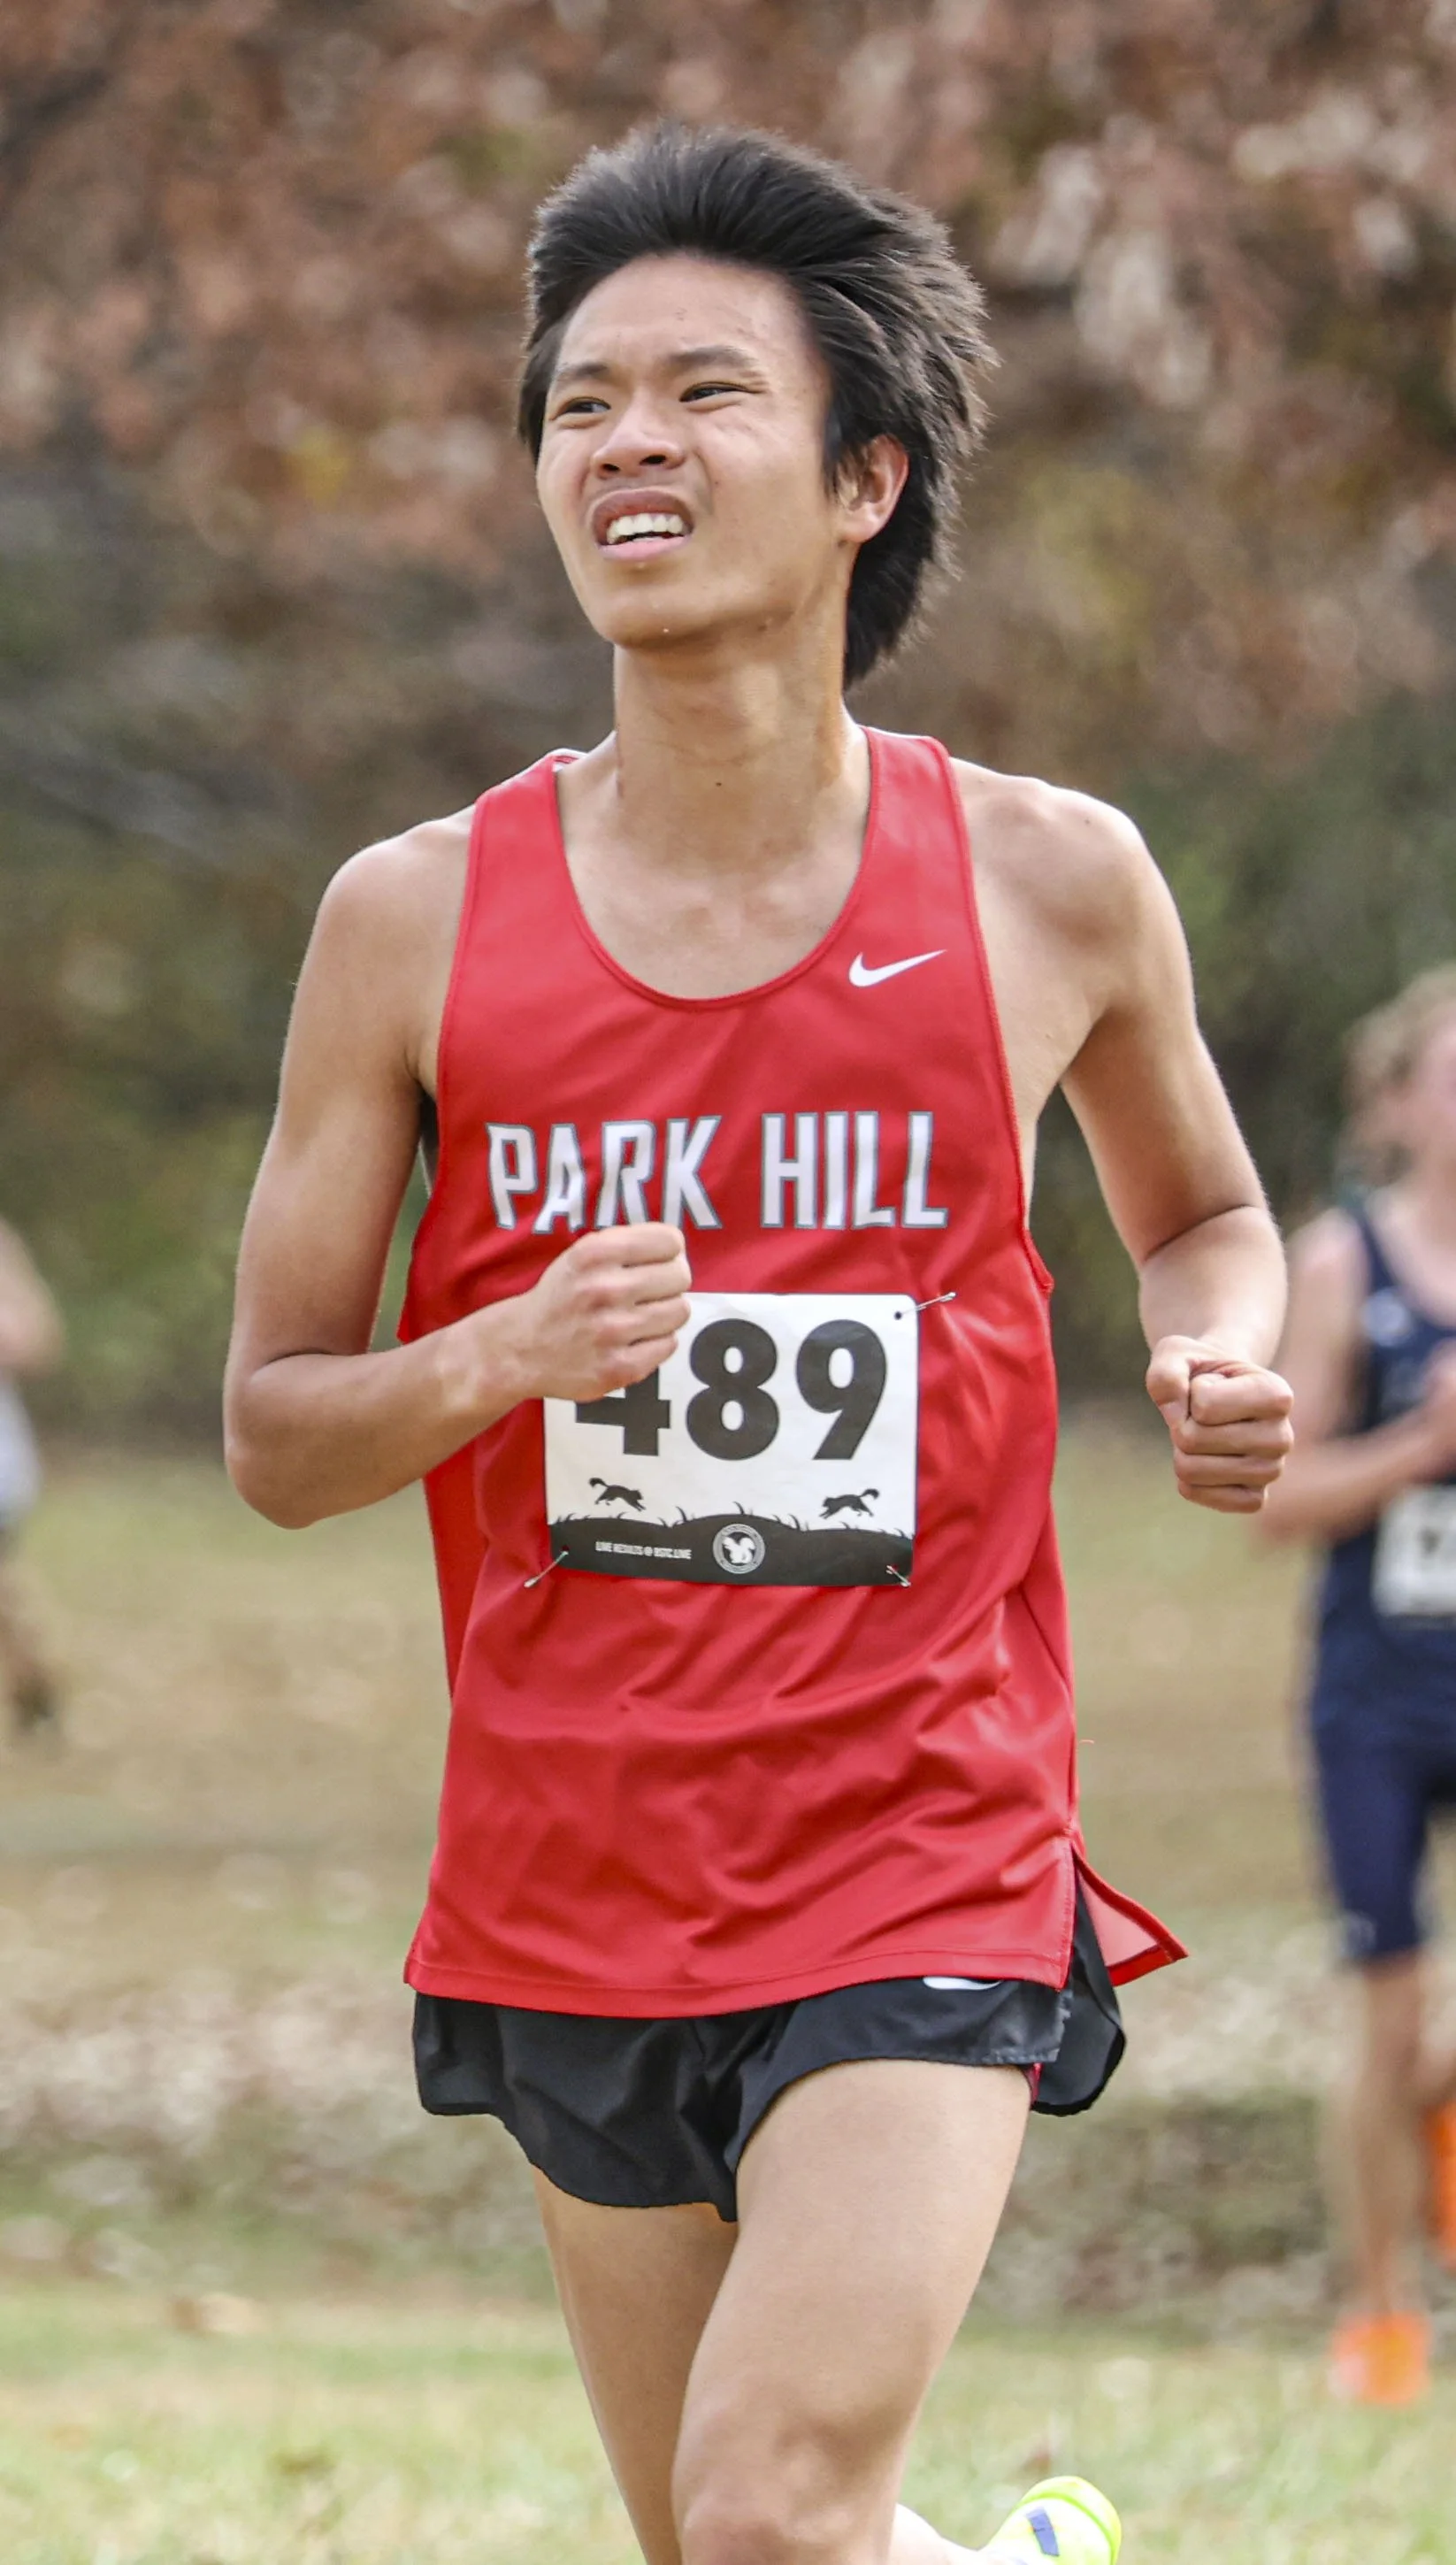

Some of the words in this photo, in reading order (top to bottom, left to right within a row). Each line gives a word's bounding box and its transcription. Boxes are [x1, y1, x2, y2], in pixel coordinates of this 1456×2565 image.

[485, 1116, 723, 1234] PARK
[760, 1111, 950, 1229] HILL
[575, 1317, 888, 1462] 489
